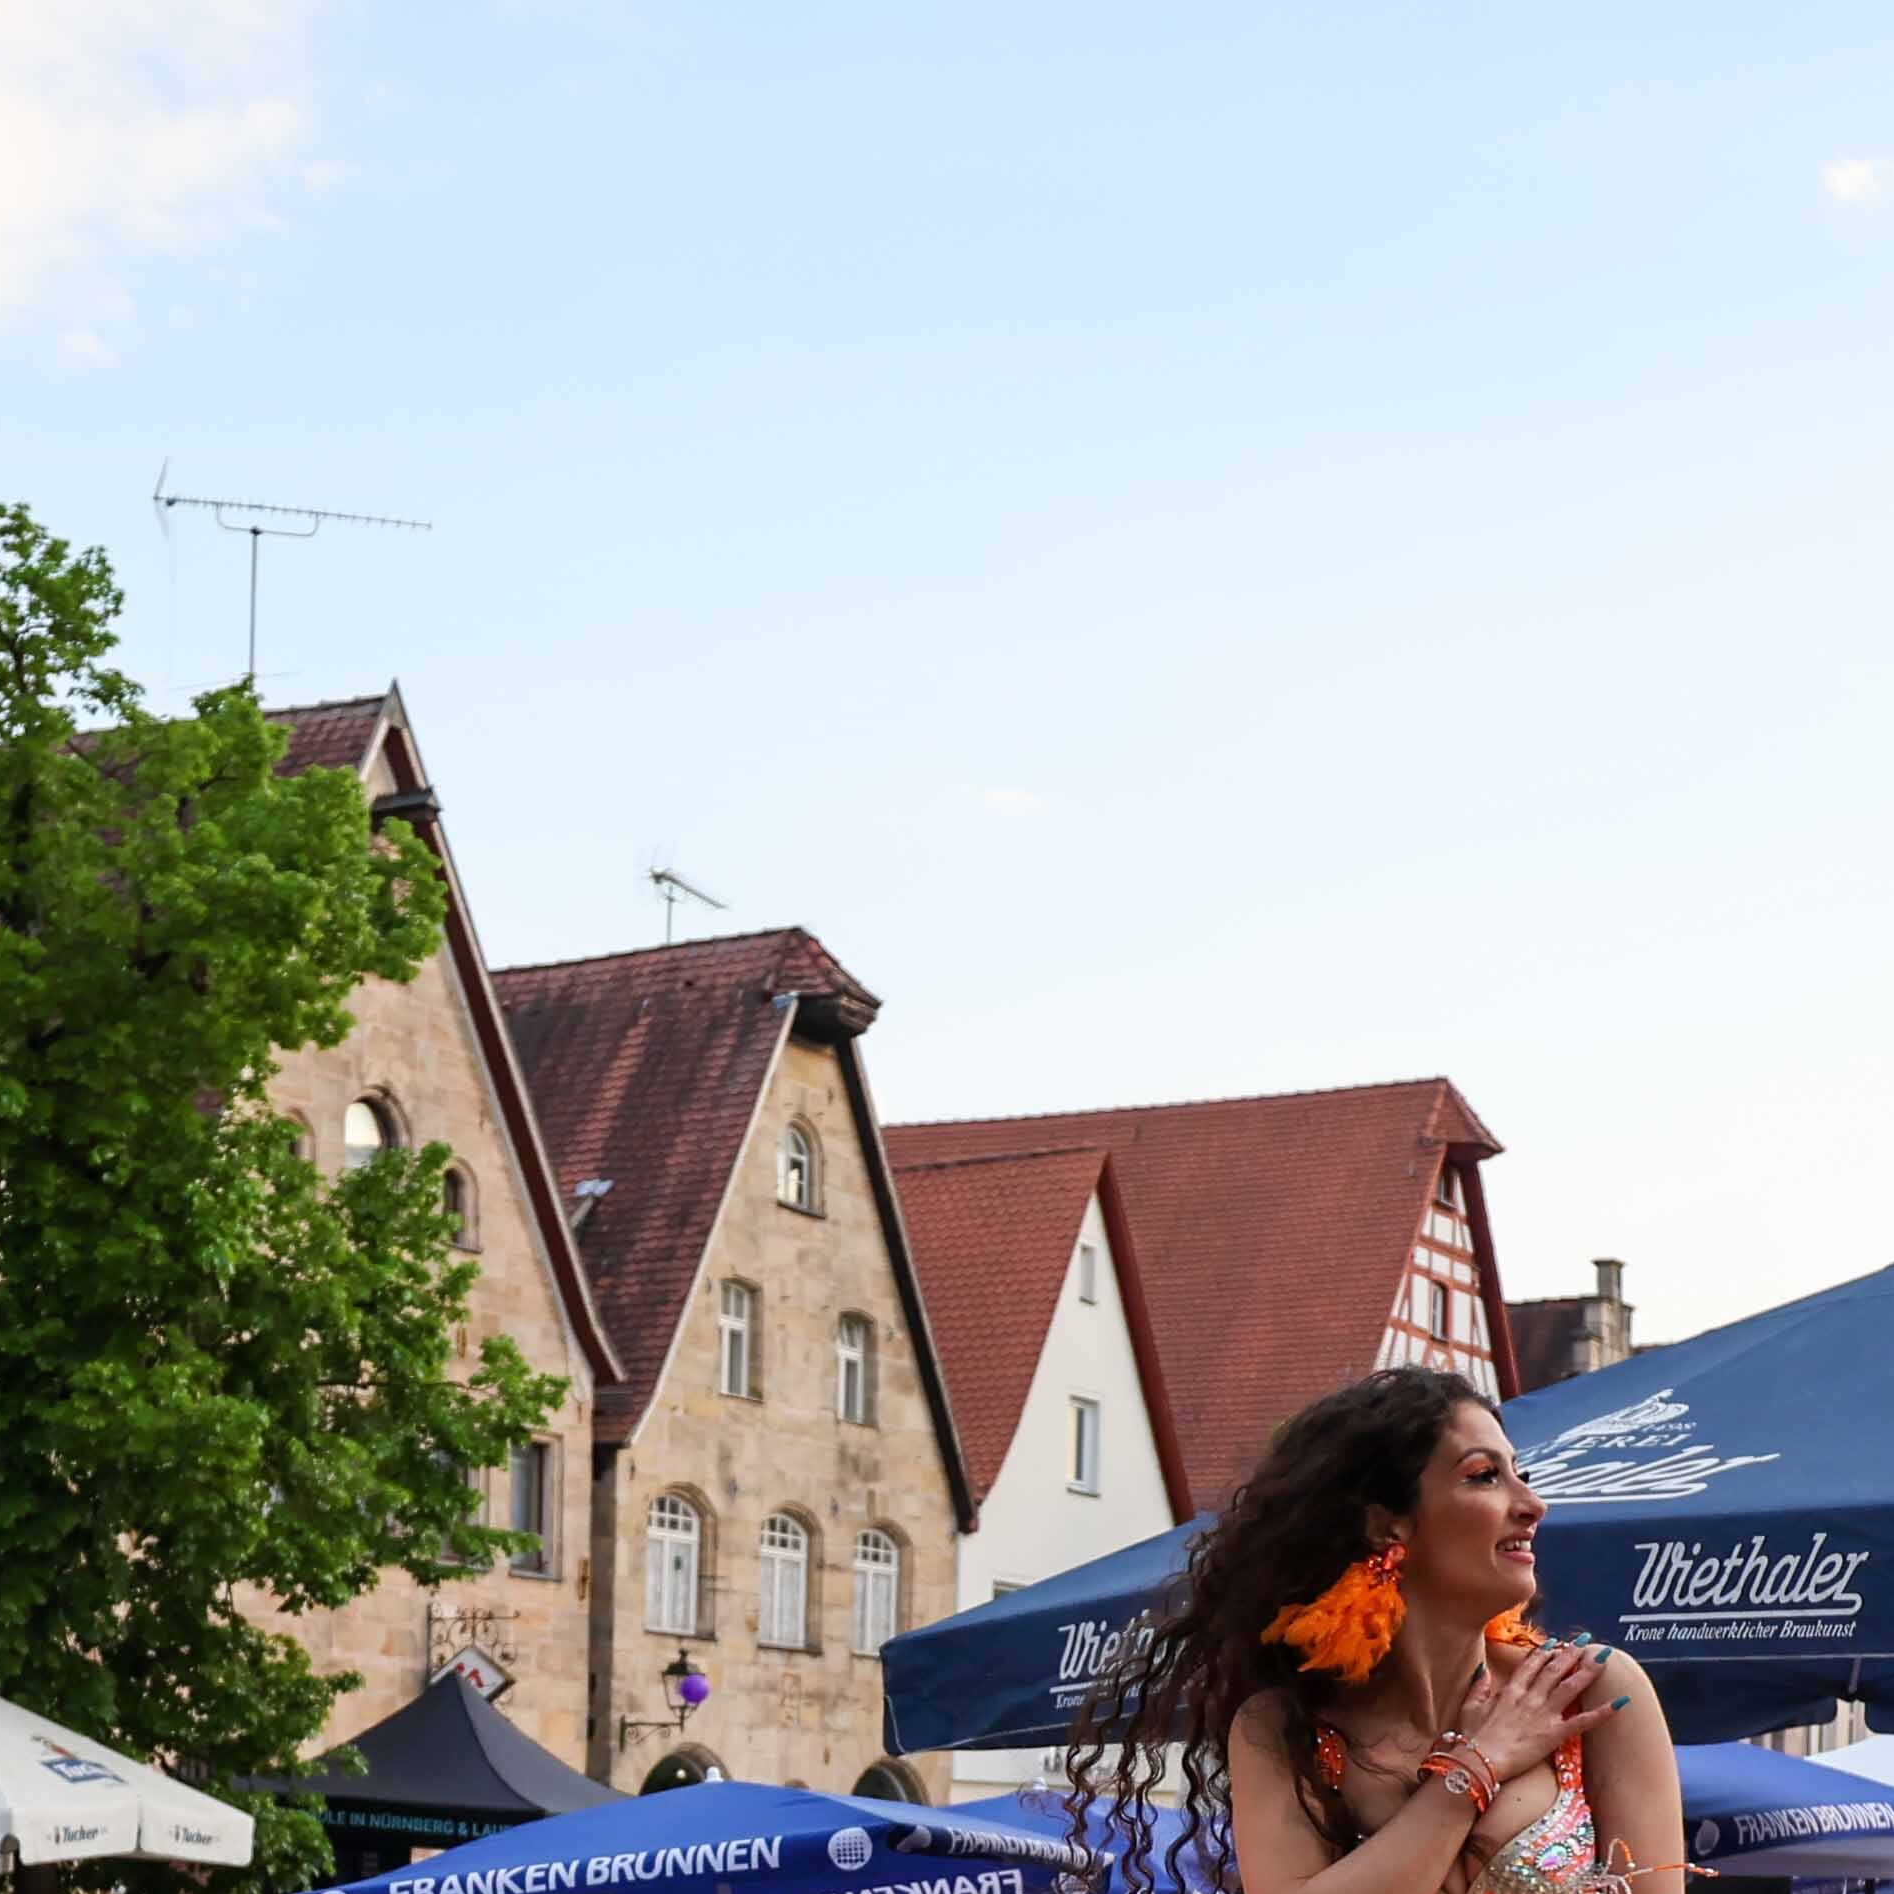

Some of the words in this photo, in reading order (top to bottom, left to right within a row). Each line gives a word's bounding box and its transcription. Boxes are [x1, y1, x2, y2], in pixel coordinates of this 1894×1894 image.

[1633, 1532, 1870, 1612] Wiethaler
[1624, 1623, 1665, 1641] Krone
[1666, 1620, 1782, 1641] handwerklicher
[1780, 1618, 1856, 1639] Braukunst
[348, 1812, 367, 1826] IN
[369, 1811, 455, 1834] NÜRNBERG
[1733, 1807, 1819, 1845] FRANKEN
[586, 1835, 784, 1886] BRUNNEN
